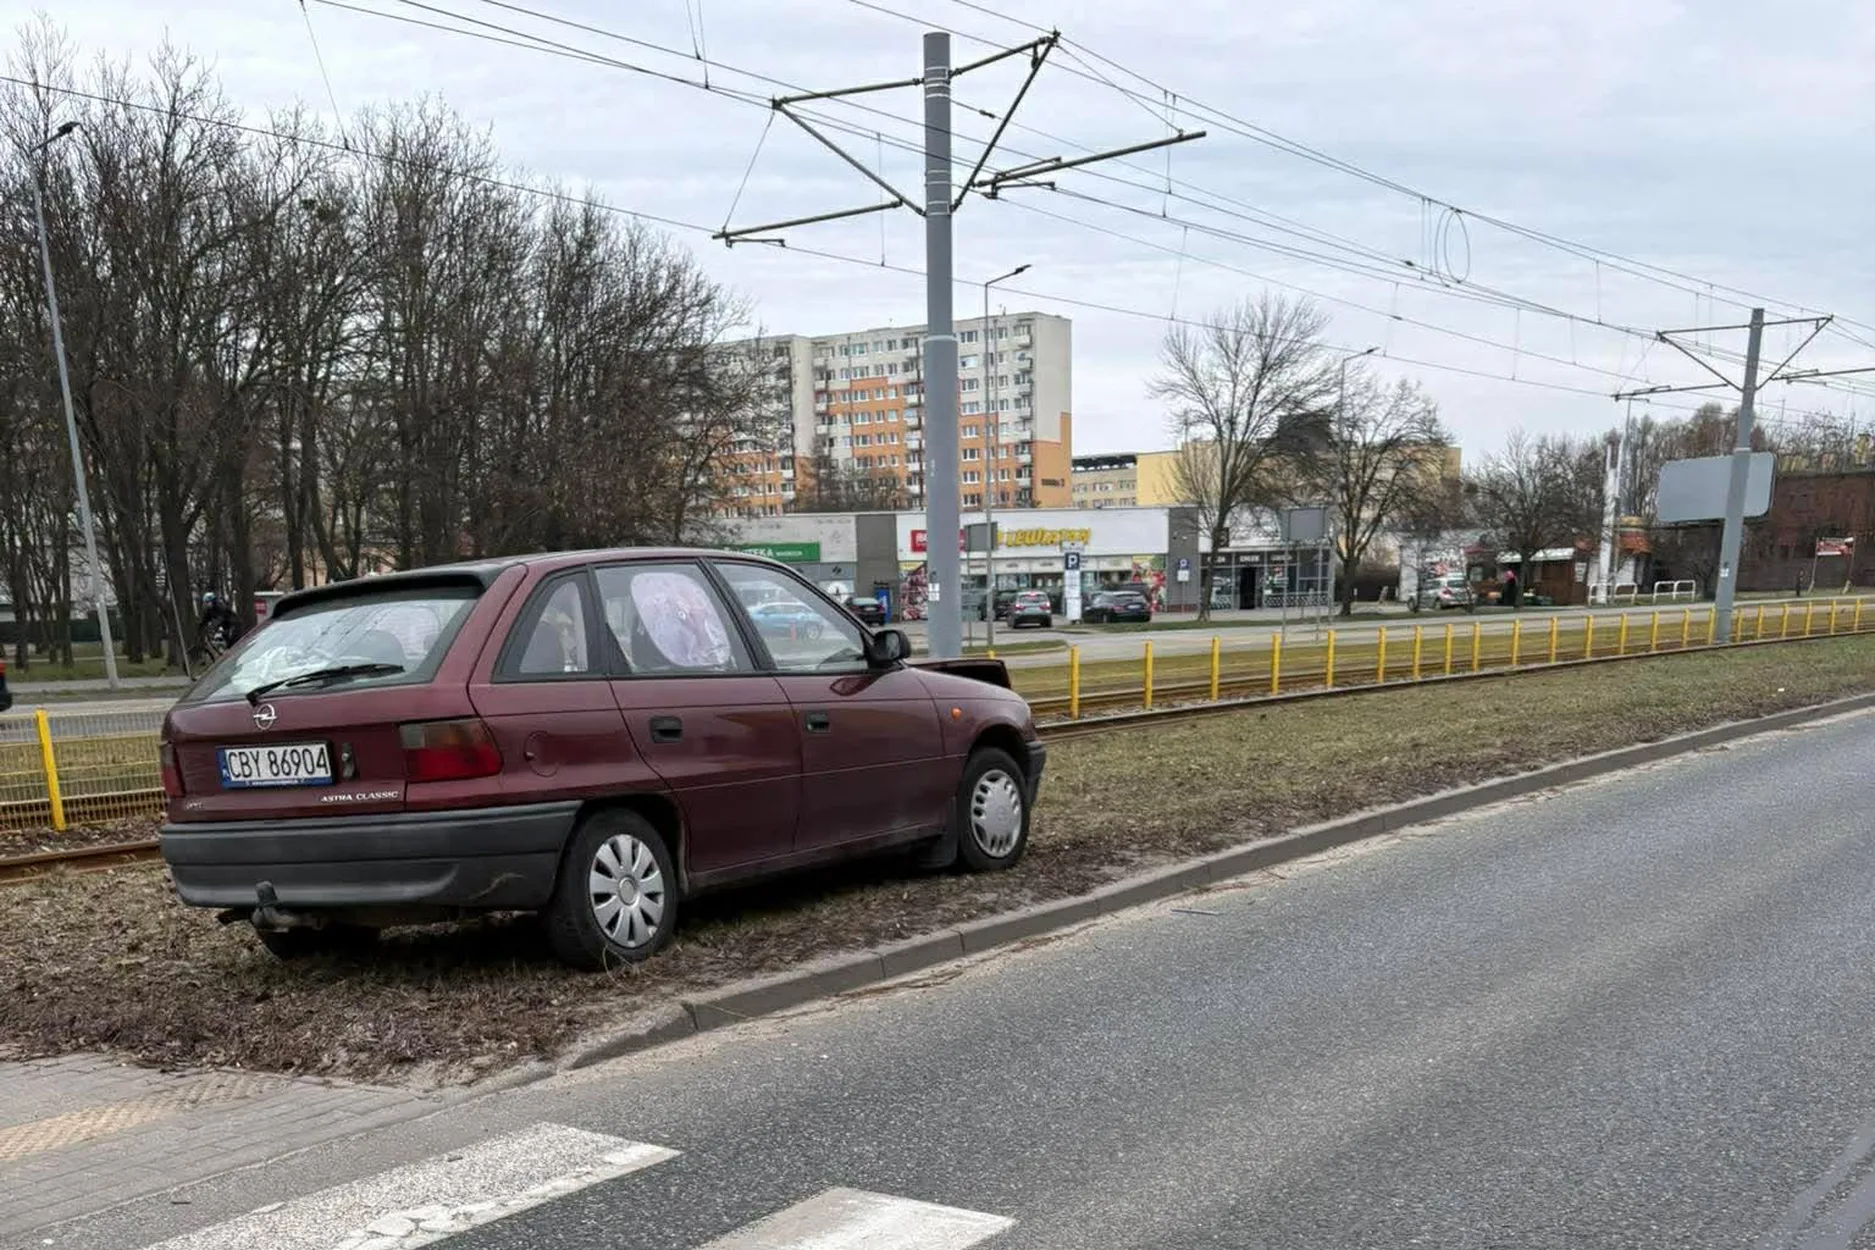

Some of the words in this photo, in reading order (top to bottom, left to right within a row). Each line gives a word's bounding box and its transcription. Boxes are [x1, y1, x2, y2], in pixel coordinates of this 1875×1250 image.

[228, 751, 263, 778] CBY
[267, 748, 330, 777] 86904
[321, 793, 353, 803] ASTRA
[356, 790, 399, 800] CLASSIC
